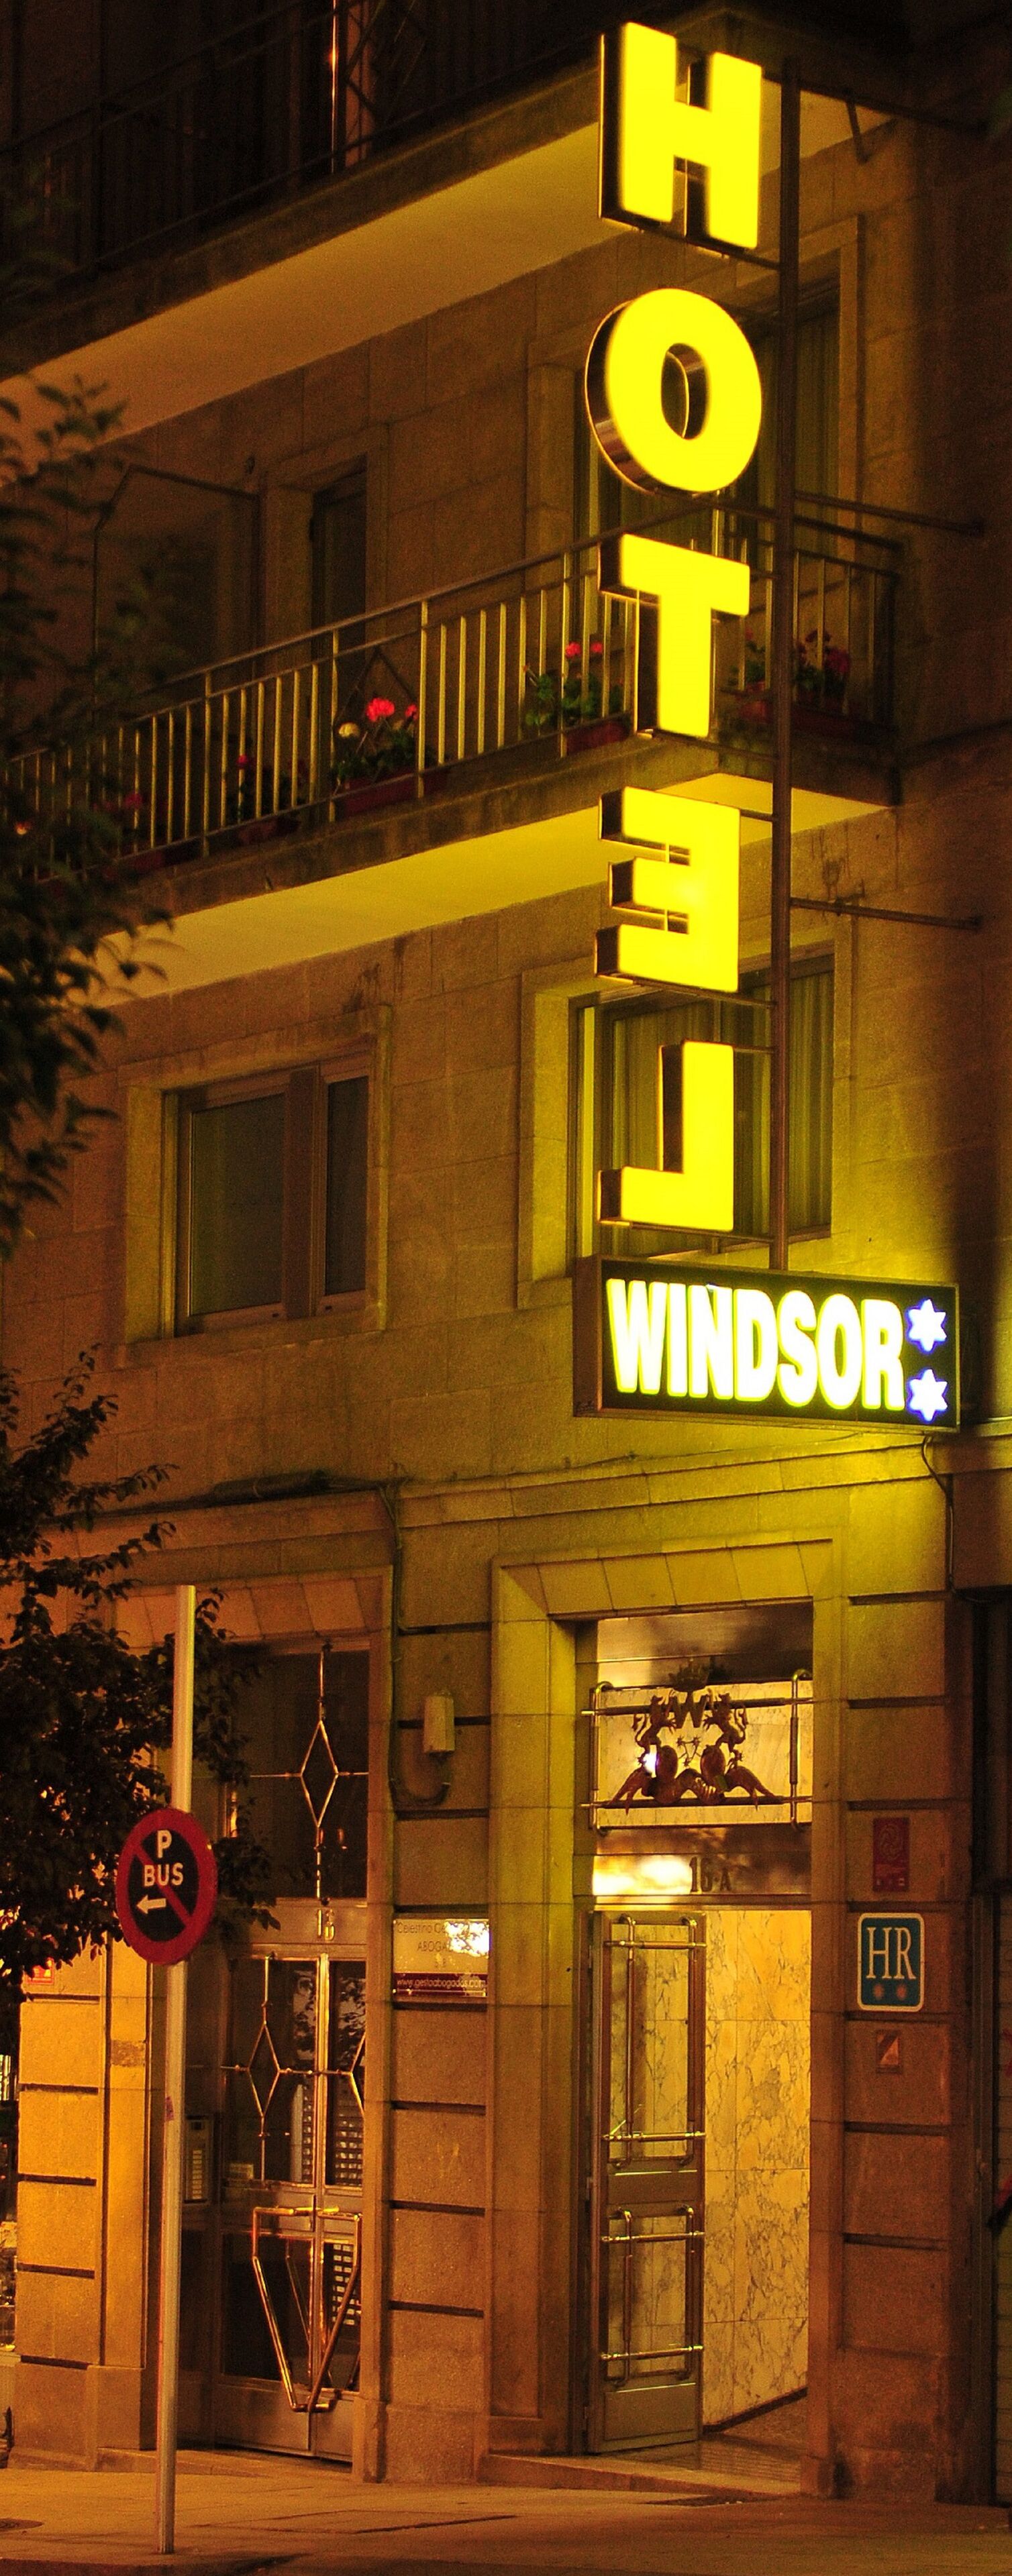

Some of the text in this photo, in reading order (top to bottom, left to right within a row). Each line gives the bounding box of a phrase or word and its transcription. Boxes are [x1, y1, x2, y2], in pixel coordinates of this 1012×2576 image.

[605, 1278, 905, 1411] WINDSOR
[156, 1829, 172, 1858] P
[143, 1862, 184, 1887] BUS
[864, 1926, 917, 1981] HR
